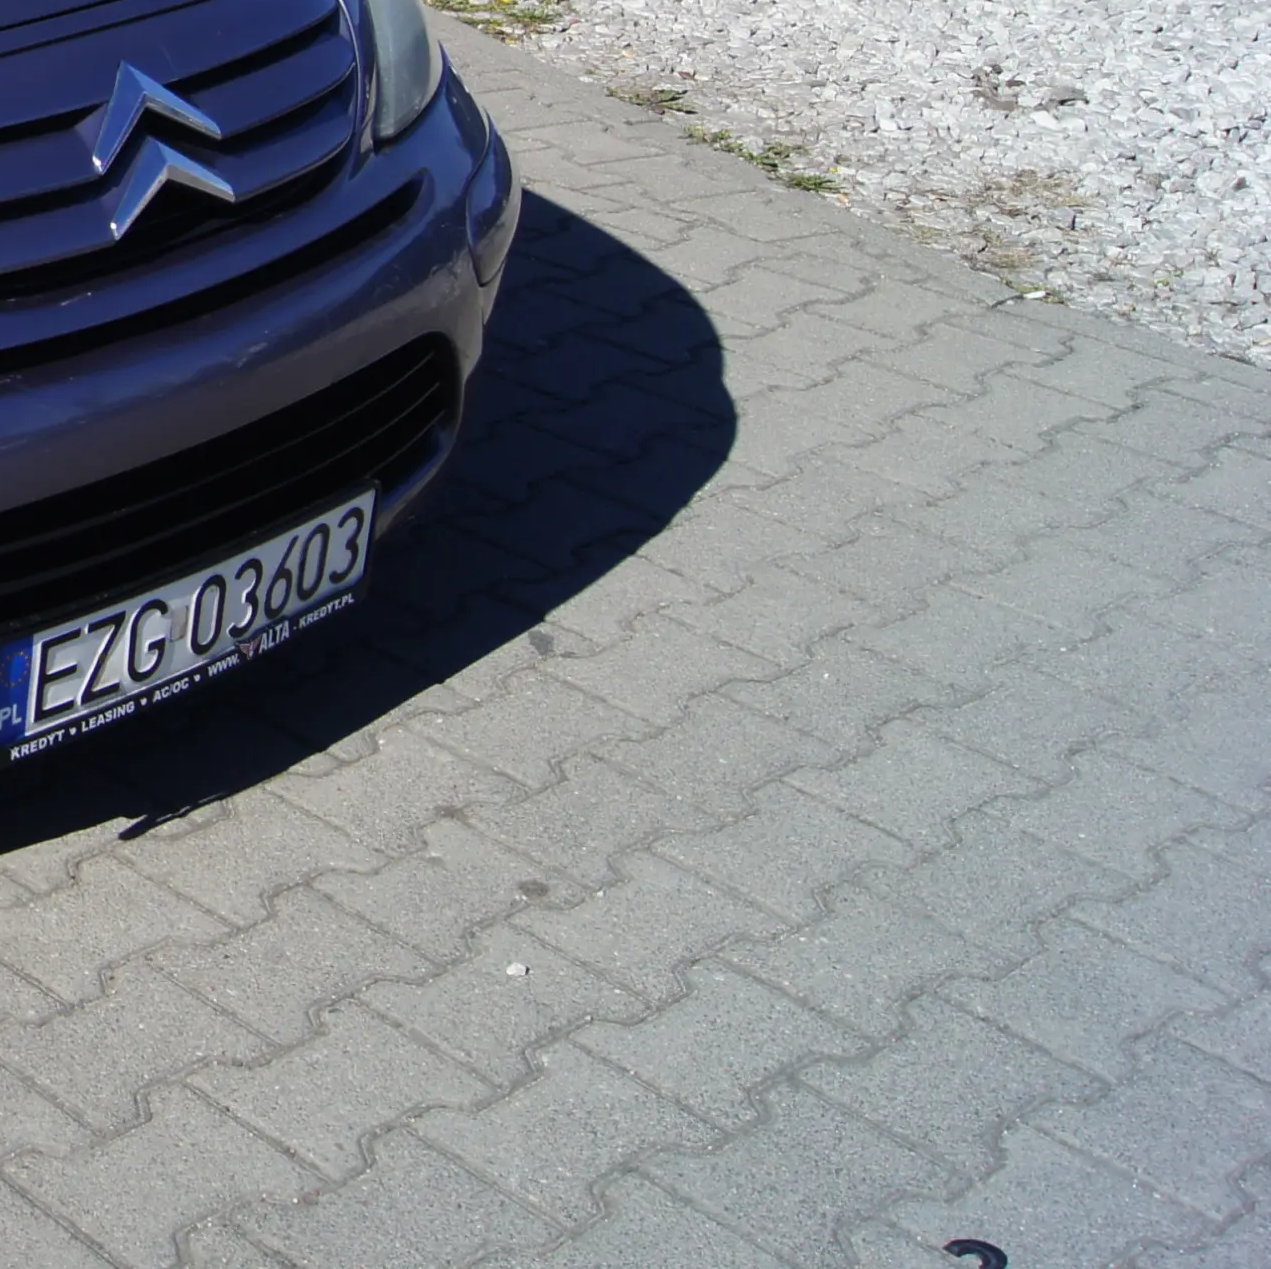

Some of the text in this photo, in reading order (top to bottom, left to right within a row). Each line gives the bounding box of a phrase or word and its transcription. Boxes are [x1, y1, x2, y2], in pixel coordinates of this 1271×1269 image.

[10, 730, 65, 761] KREDYT
[81, 701, 135, 733] LEASING
[152, 679, 190, 703] AC/OC
[258, 620, 291, 656] ALTA
[32, 507, 365, 723] EZG 03603
